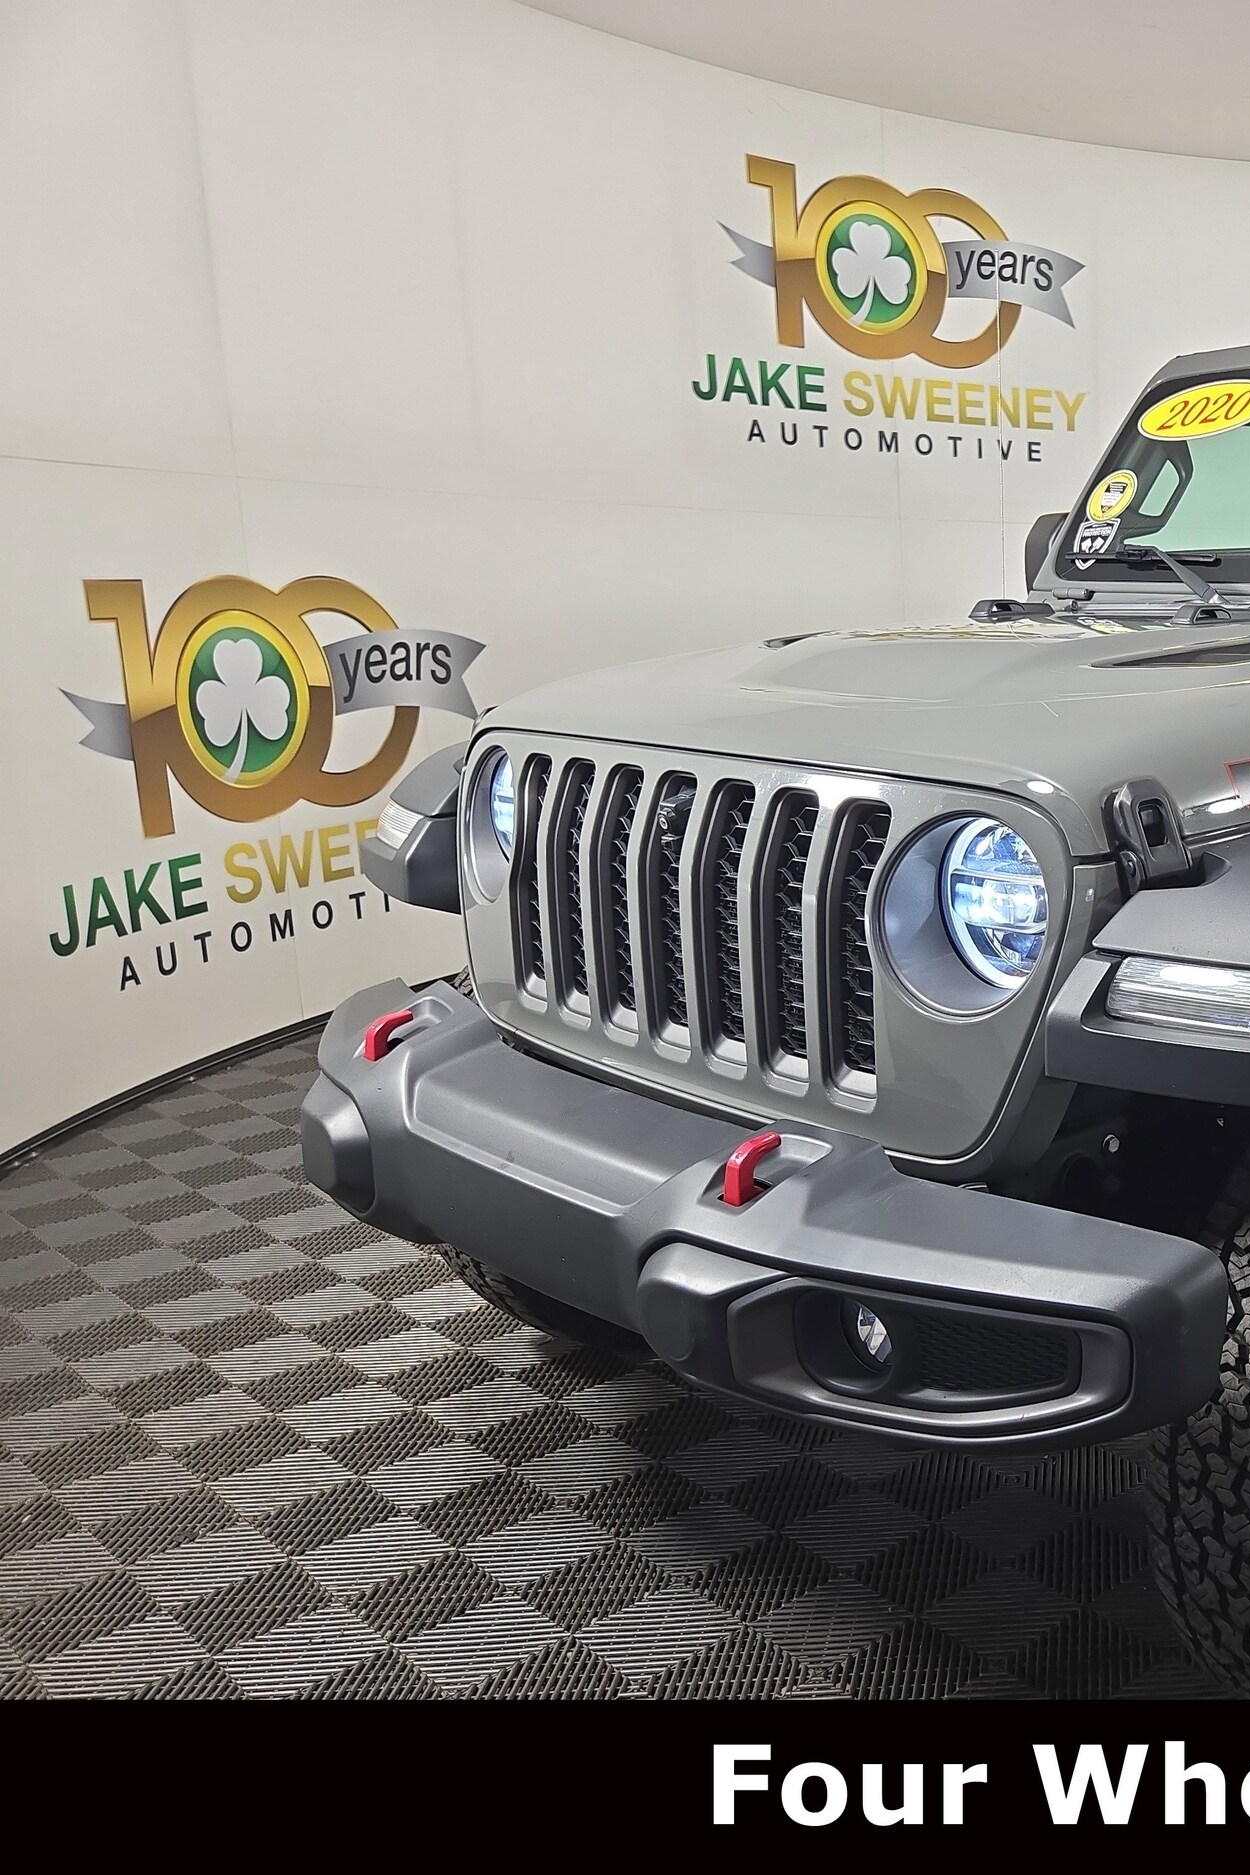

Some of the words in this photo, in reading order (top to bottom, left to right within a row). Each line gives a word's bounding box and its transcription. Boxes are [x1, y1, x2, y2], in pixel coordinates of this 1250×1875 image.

[955, 248, 1054, 292] years
[692, 353, 828, 413] JAKE
[843, 370, 1088, 432] SWEENEY
[748, 419, 1043, 463] AUTOMOTIVE
[339, 639, 453, 704] years
[49, 853, 209, 958] JAKE
[120, 891, 390, 991] AUTOMOTI
